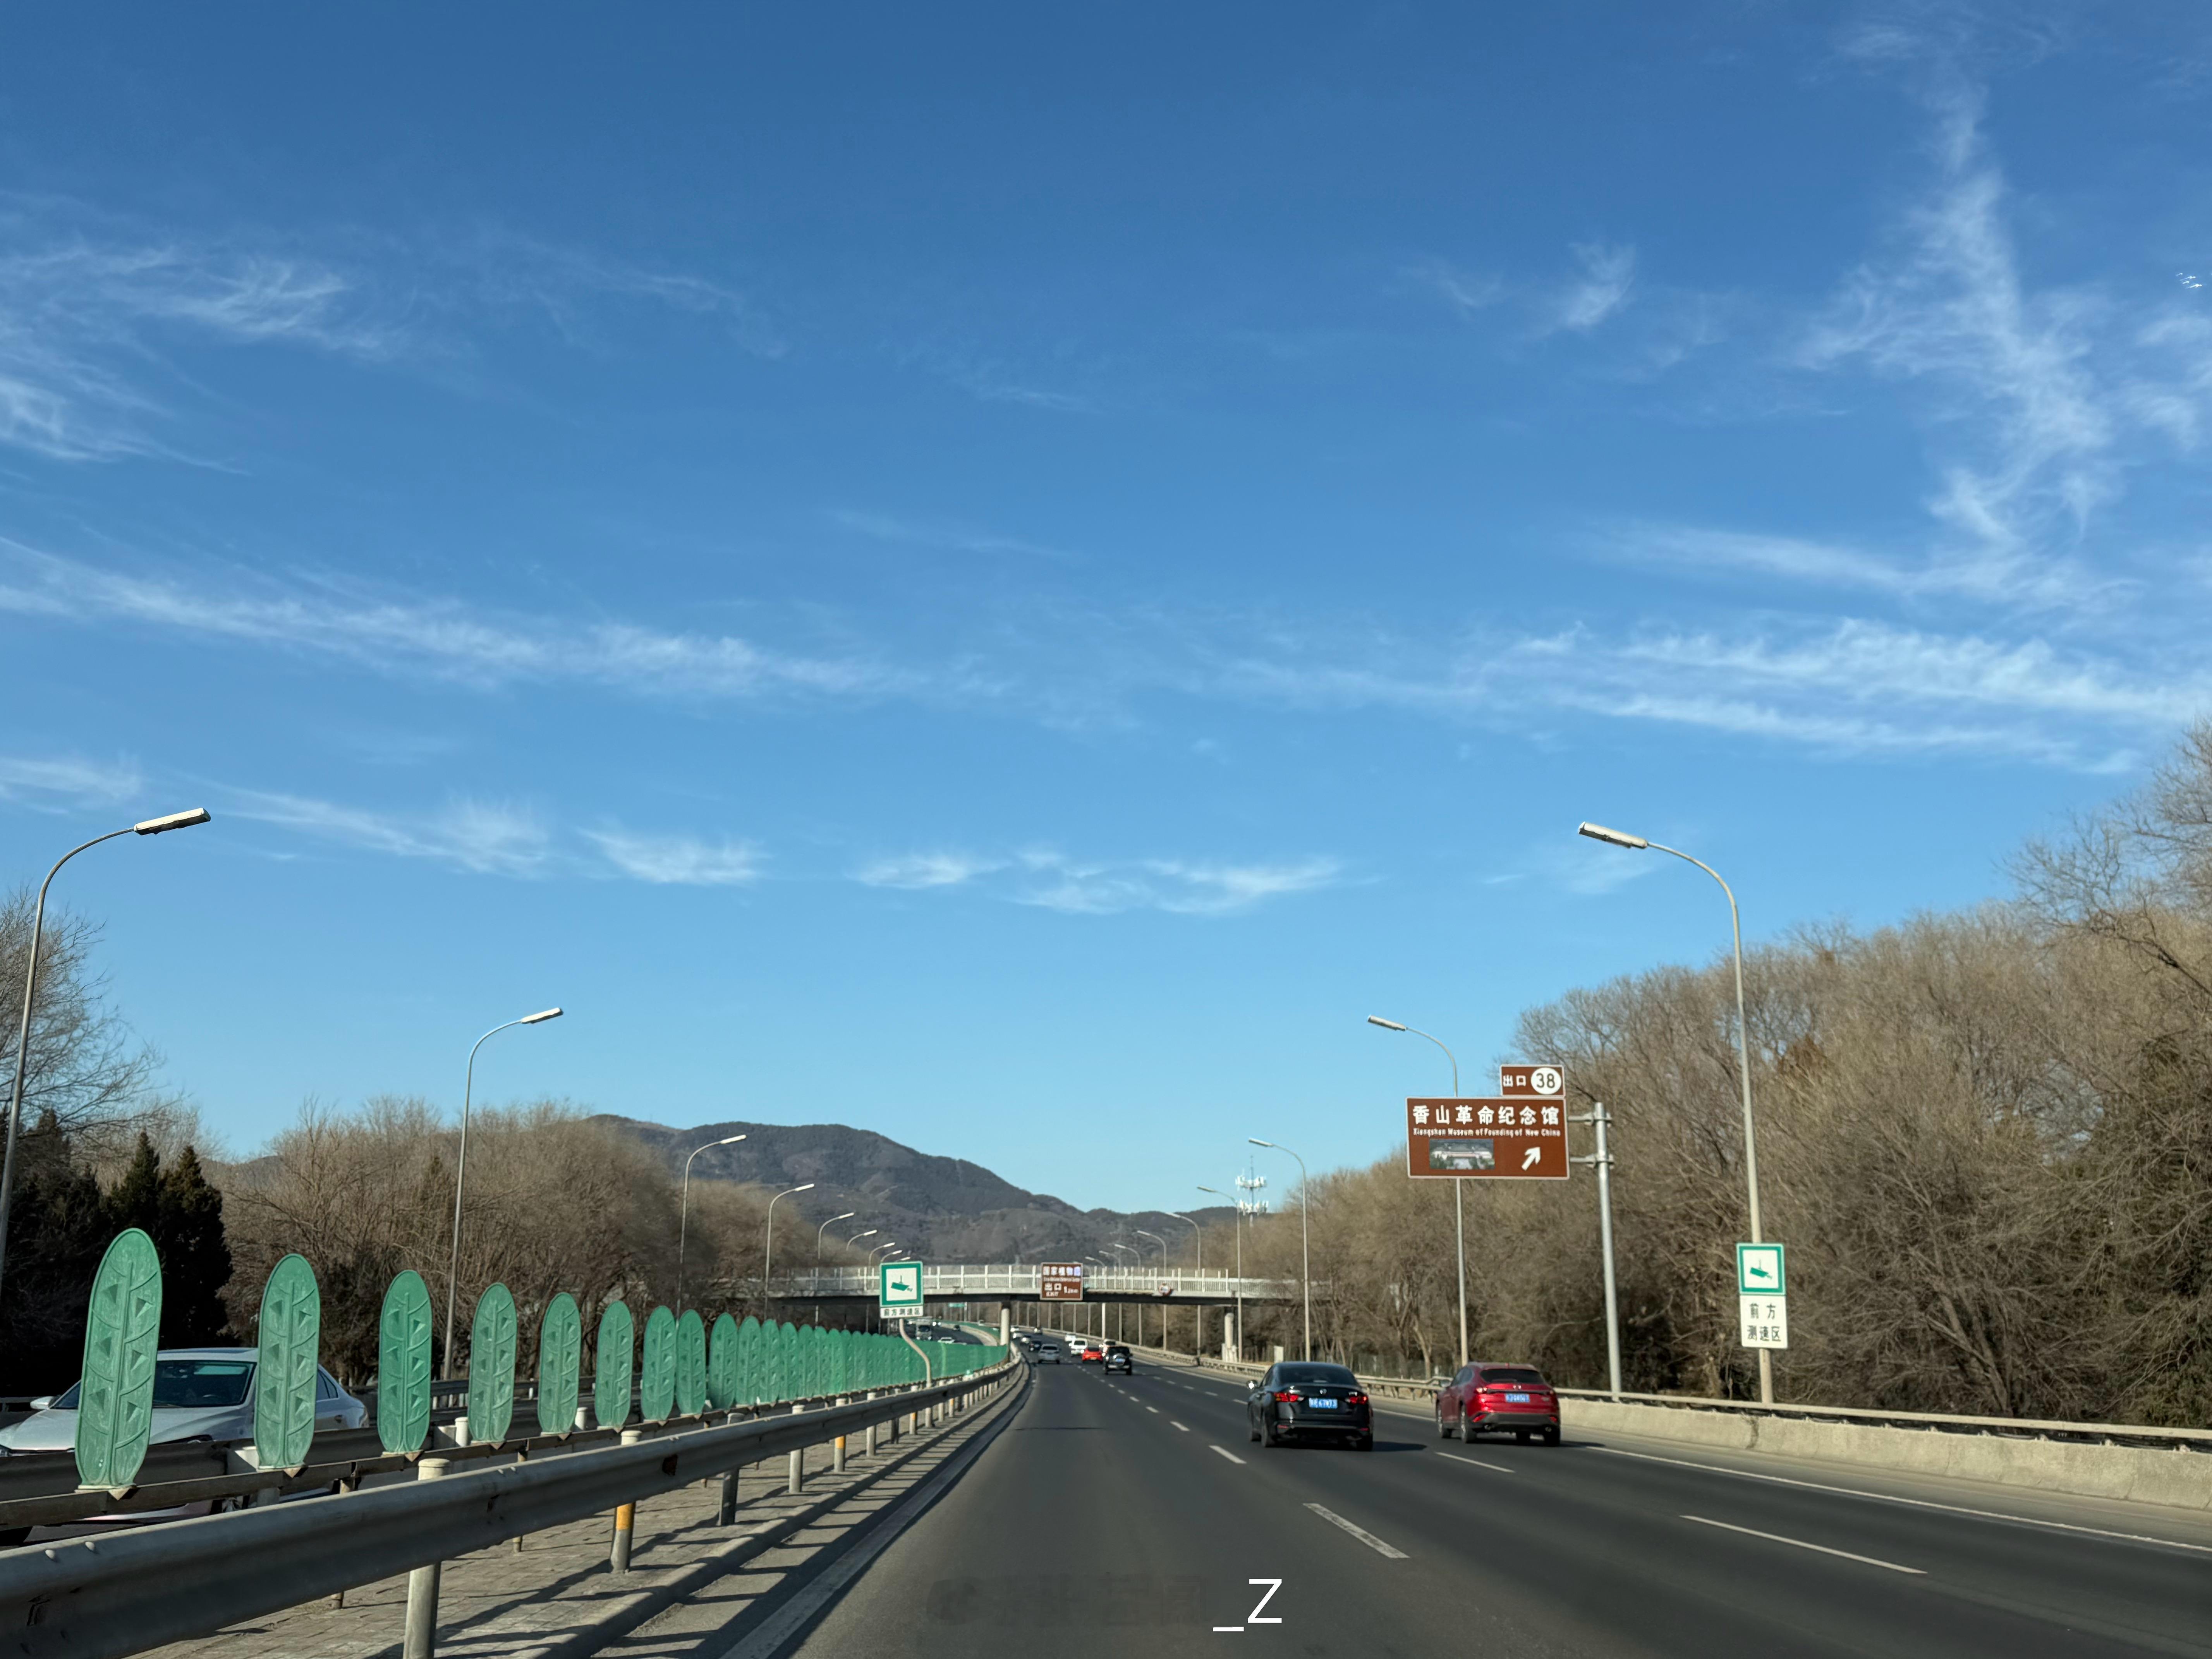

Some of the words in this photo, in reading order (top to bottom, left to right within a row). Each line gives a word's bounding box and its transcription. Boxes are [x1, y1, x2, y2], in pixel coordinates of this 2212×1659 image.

[1503, 1075, 1526, 1087] 出口
[1536, 1073, 1555, 1089] 38
[1413, 1105, 1559, 1125] 香山革命纪念馆
[1448, 1128, 1474, 1136] Museum
[1525, 1128, 1539, 1137] New
[1541, 1128, 1561, 1137] China
[1749, 1303, 1776, 1320] 前方
[1747, 1325, 1781, 1342] 测速区
